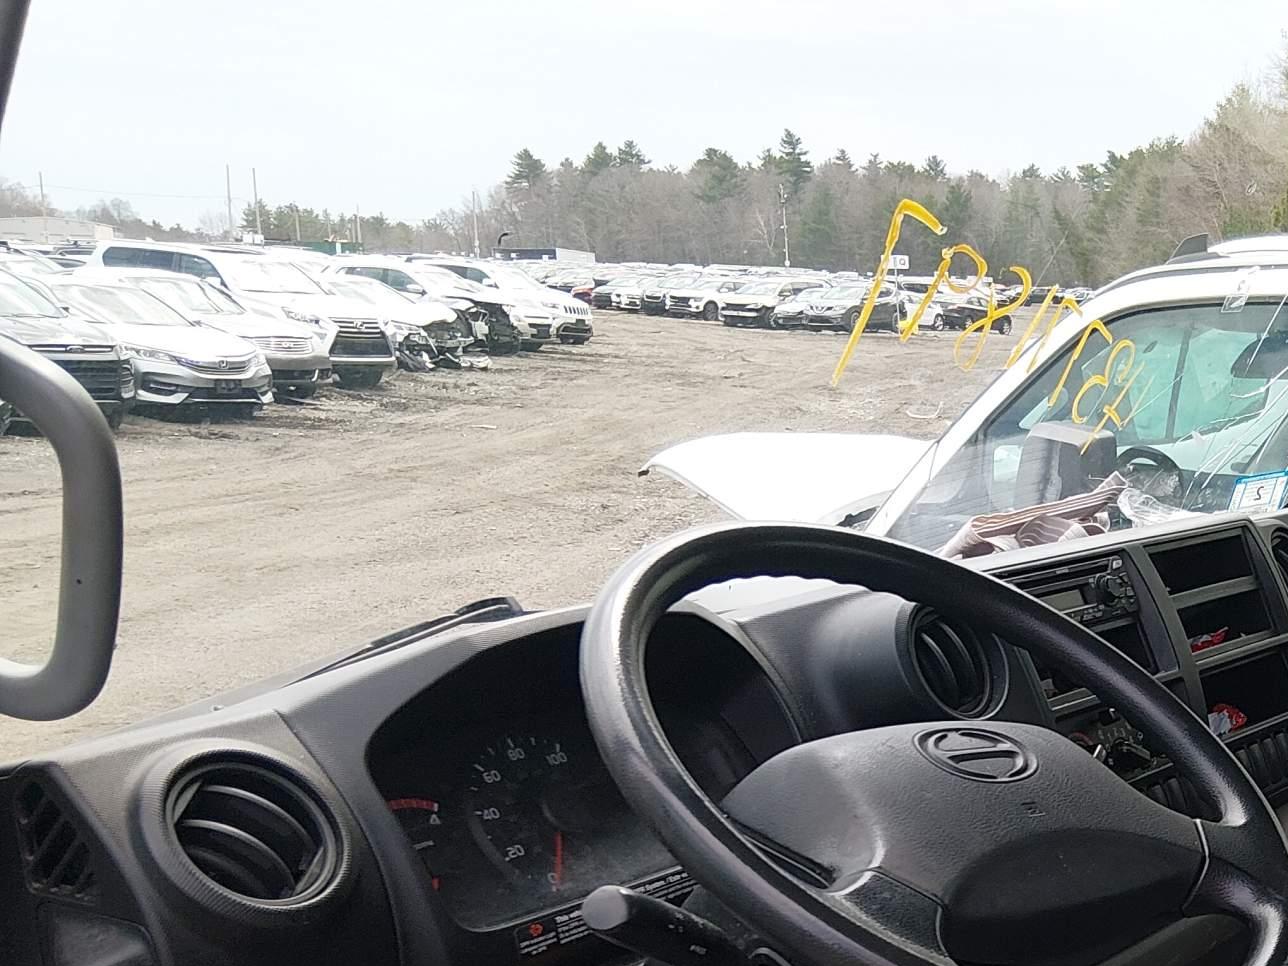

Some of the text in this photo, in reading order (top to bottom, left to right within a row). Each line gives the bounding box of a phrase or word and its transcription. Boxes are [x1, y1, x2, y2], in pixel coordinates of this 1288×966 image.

[546, 752, 567, 765] 100
[482, 770, 501, 783] 60
[482, 807, 500, 820] 40
[506, 845, 525, 859] 20
